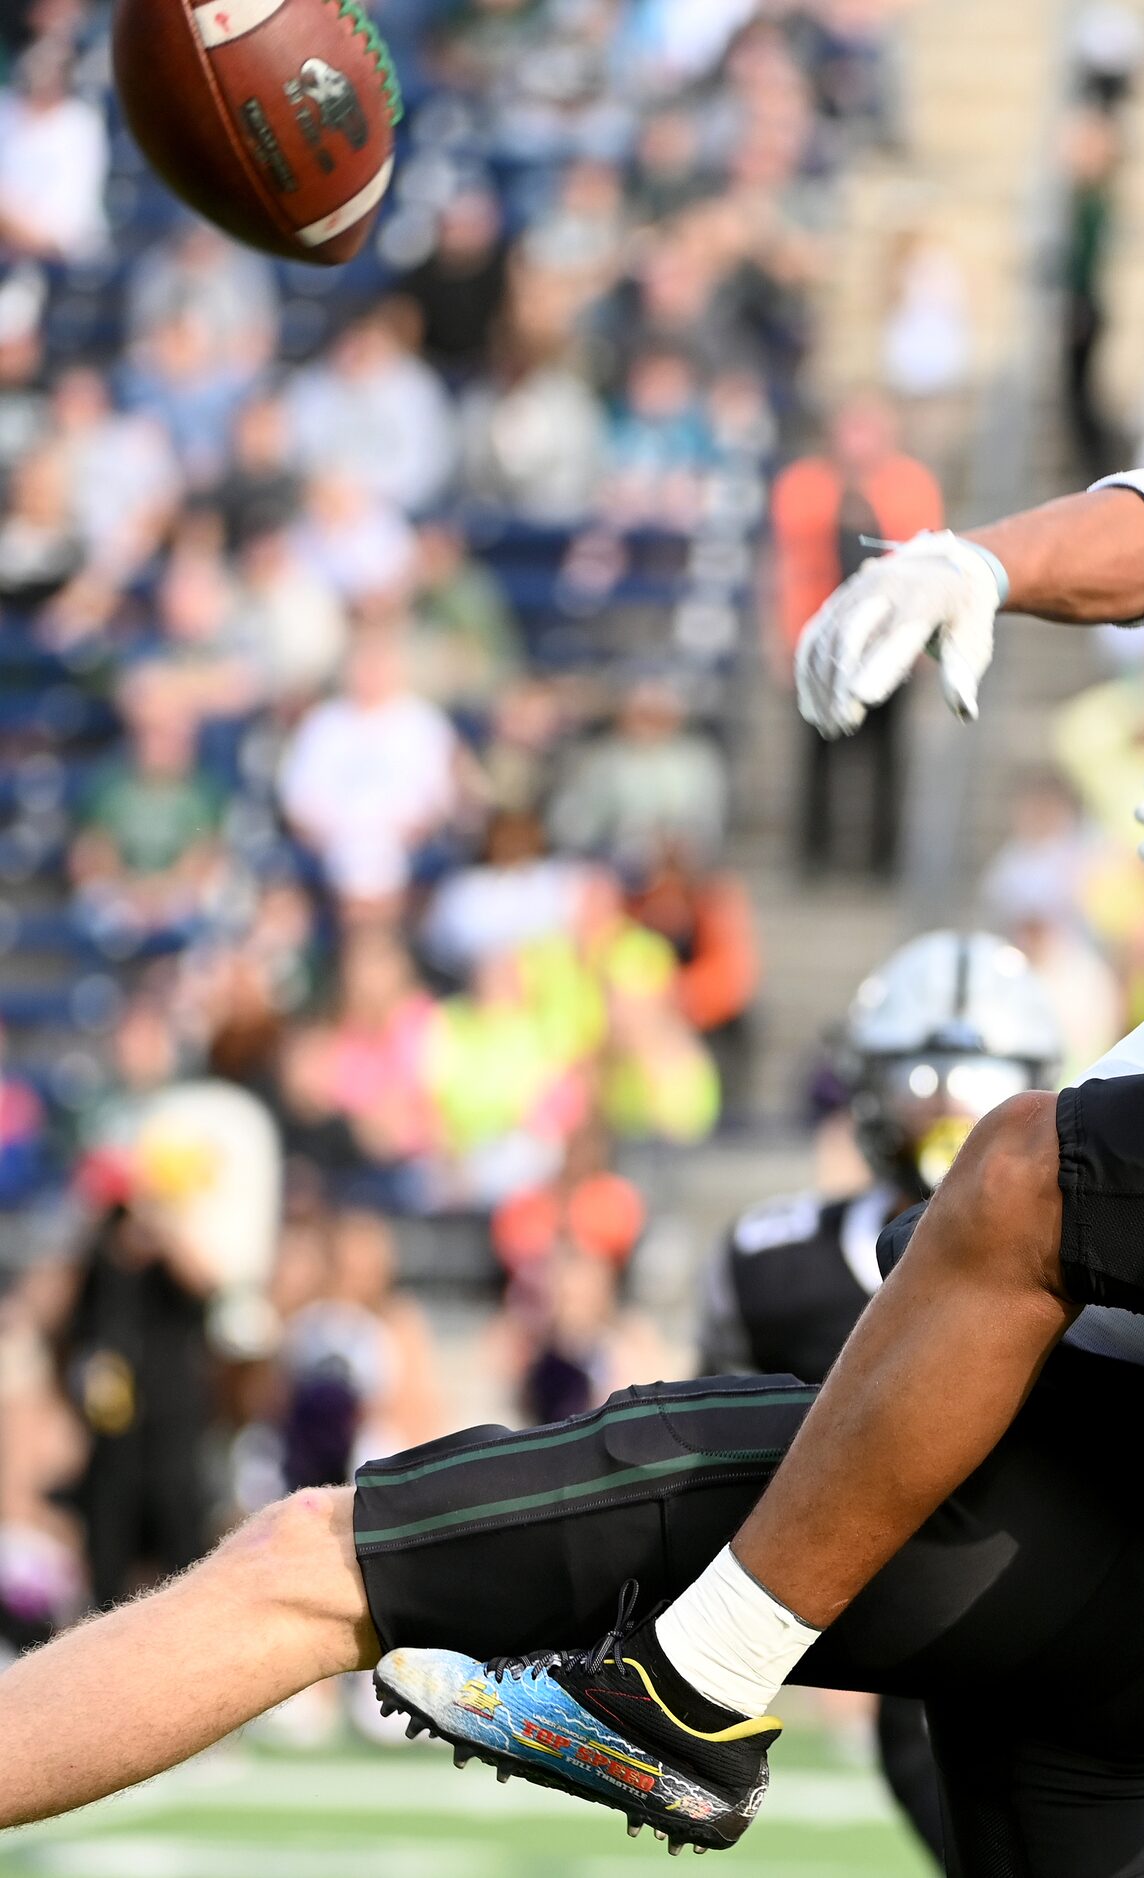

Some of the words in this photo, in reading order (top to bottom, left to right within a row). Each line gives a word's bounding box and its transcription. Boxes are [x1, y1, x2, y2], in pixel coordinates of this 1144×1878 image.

[522, 1718, 571, 1751] TOP
[575, 1746, 656, 1793] SPEED
[565, 1756, 592, 1773] FULL
[596, 1768, 648, 1800] THROTTLE
